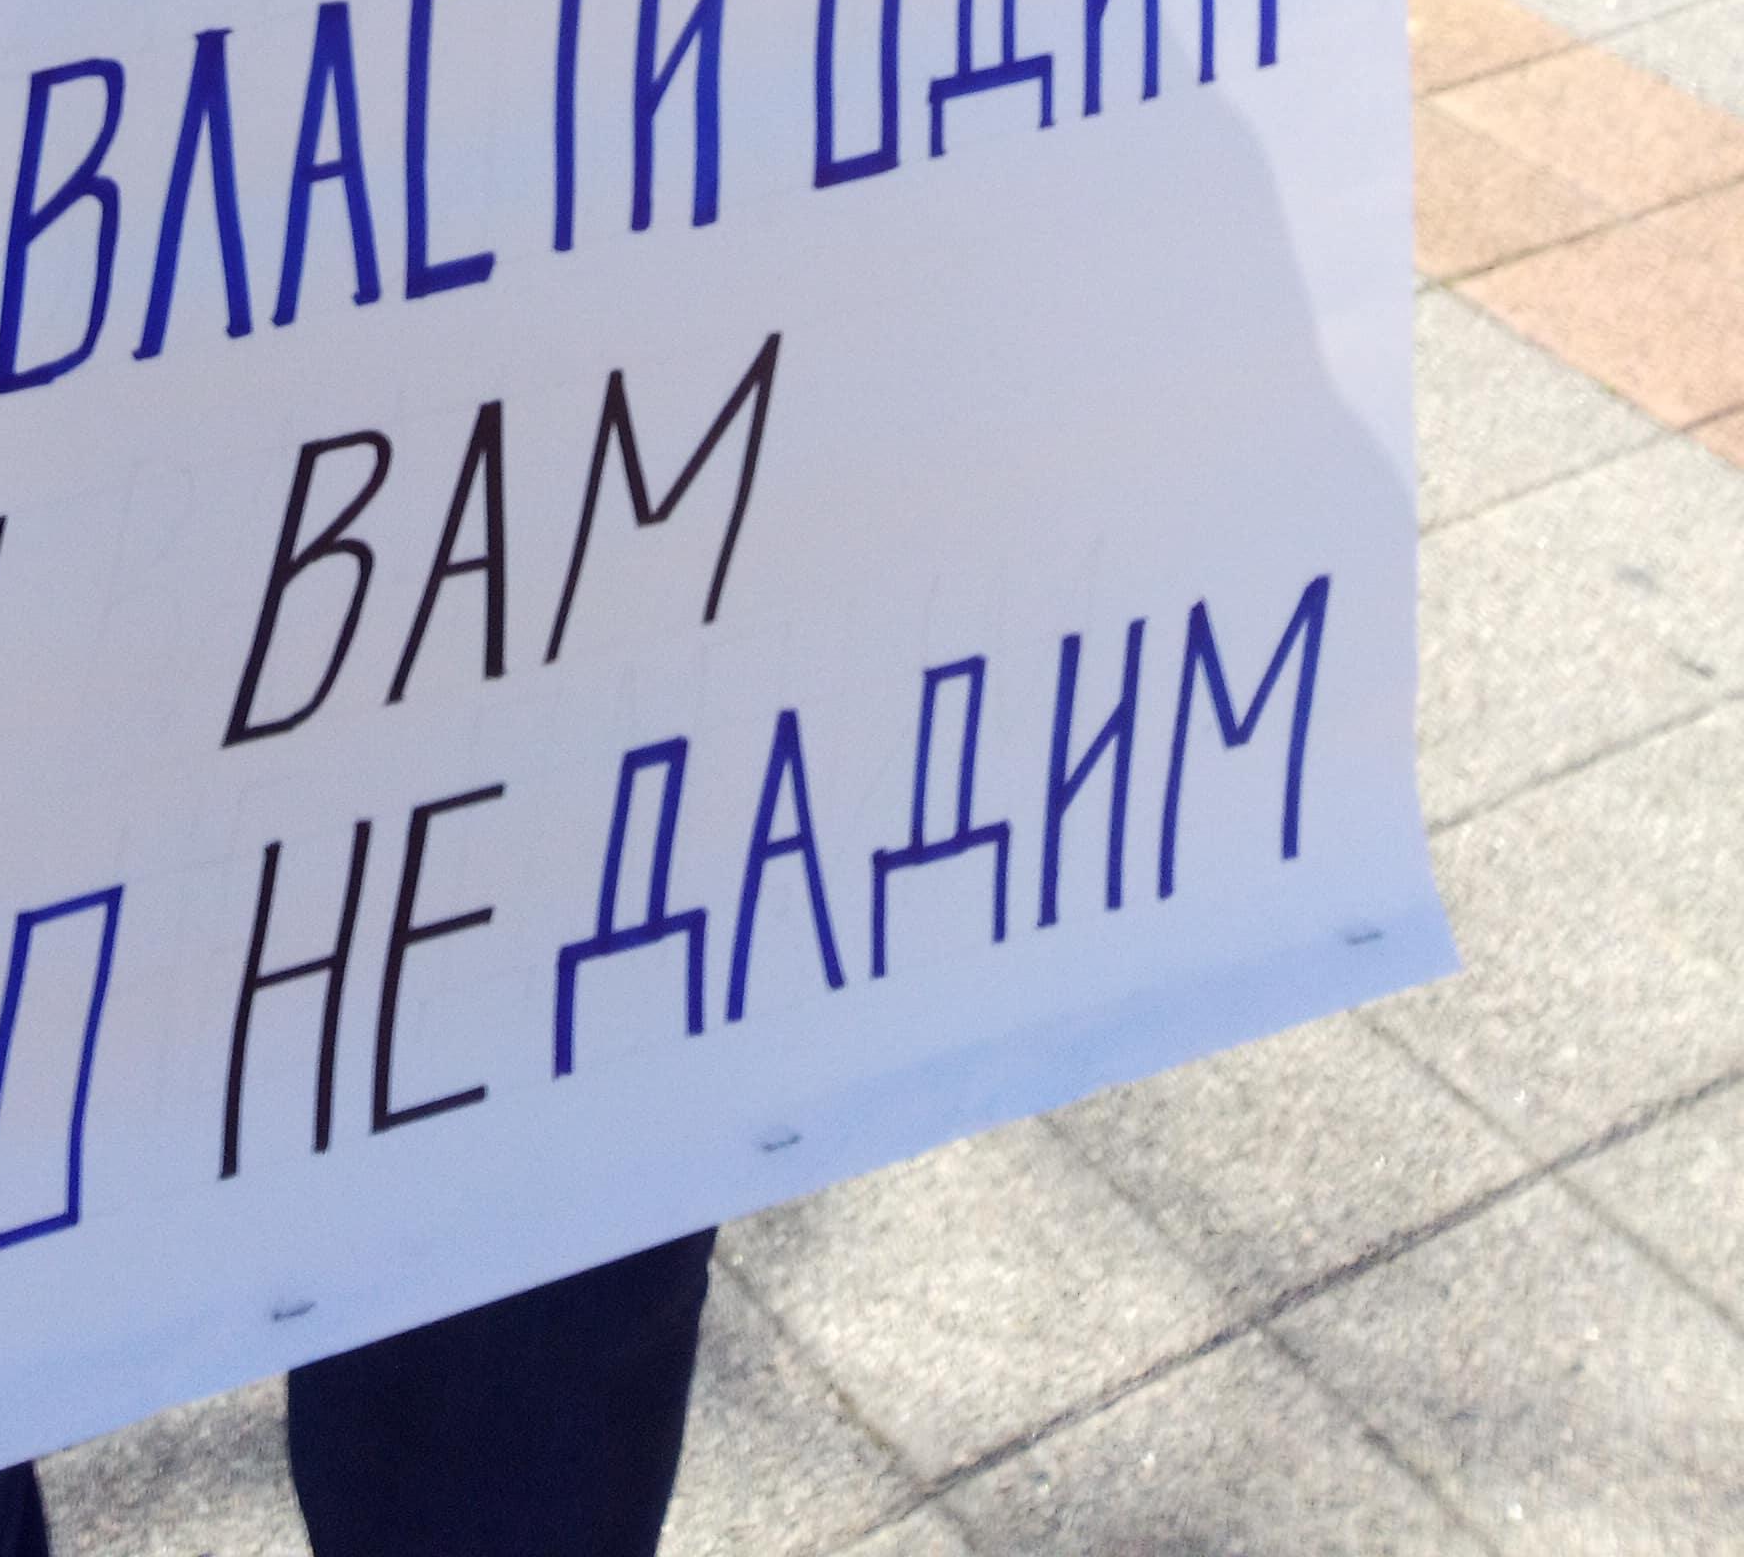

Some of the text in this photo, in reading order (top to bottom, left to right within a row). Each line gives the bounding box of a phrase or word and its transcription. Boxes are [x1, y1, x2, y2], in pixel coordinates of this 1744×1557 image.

[221, 332, 781, 748] ВАМ
[219, 783, 505, 1180] НЕ
[553, 575, 1330, 1078] ДАДИМ
